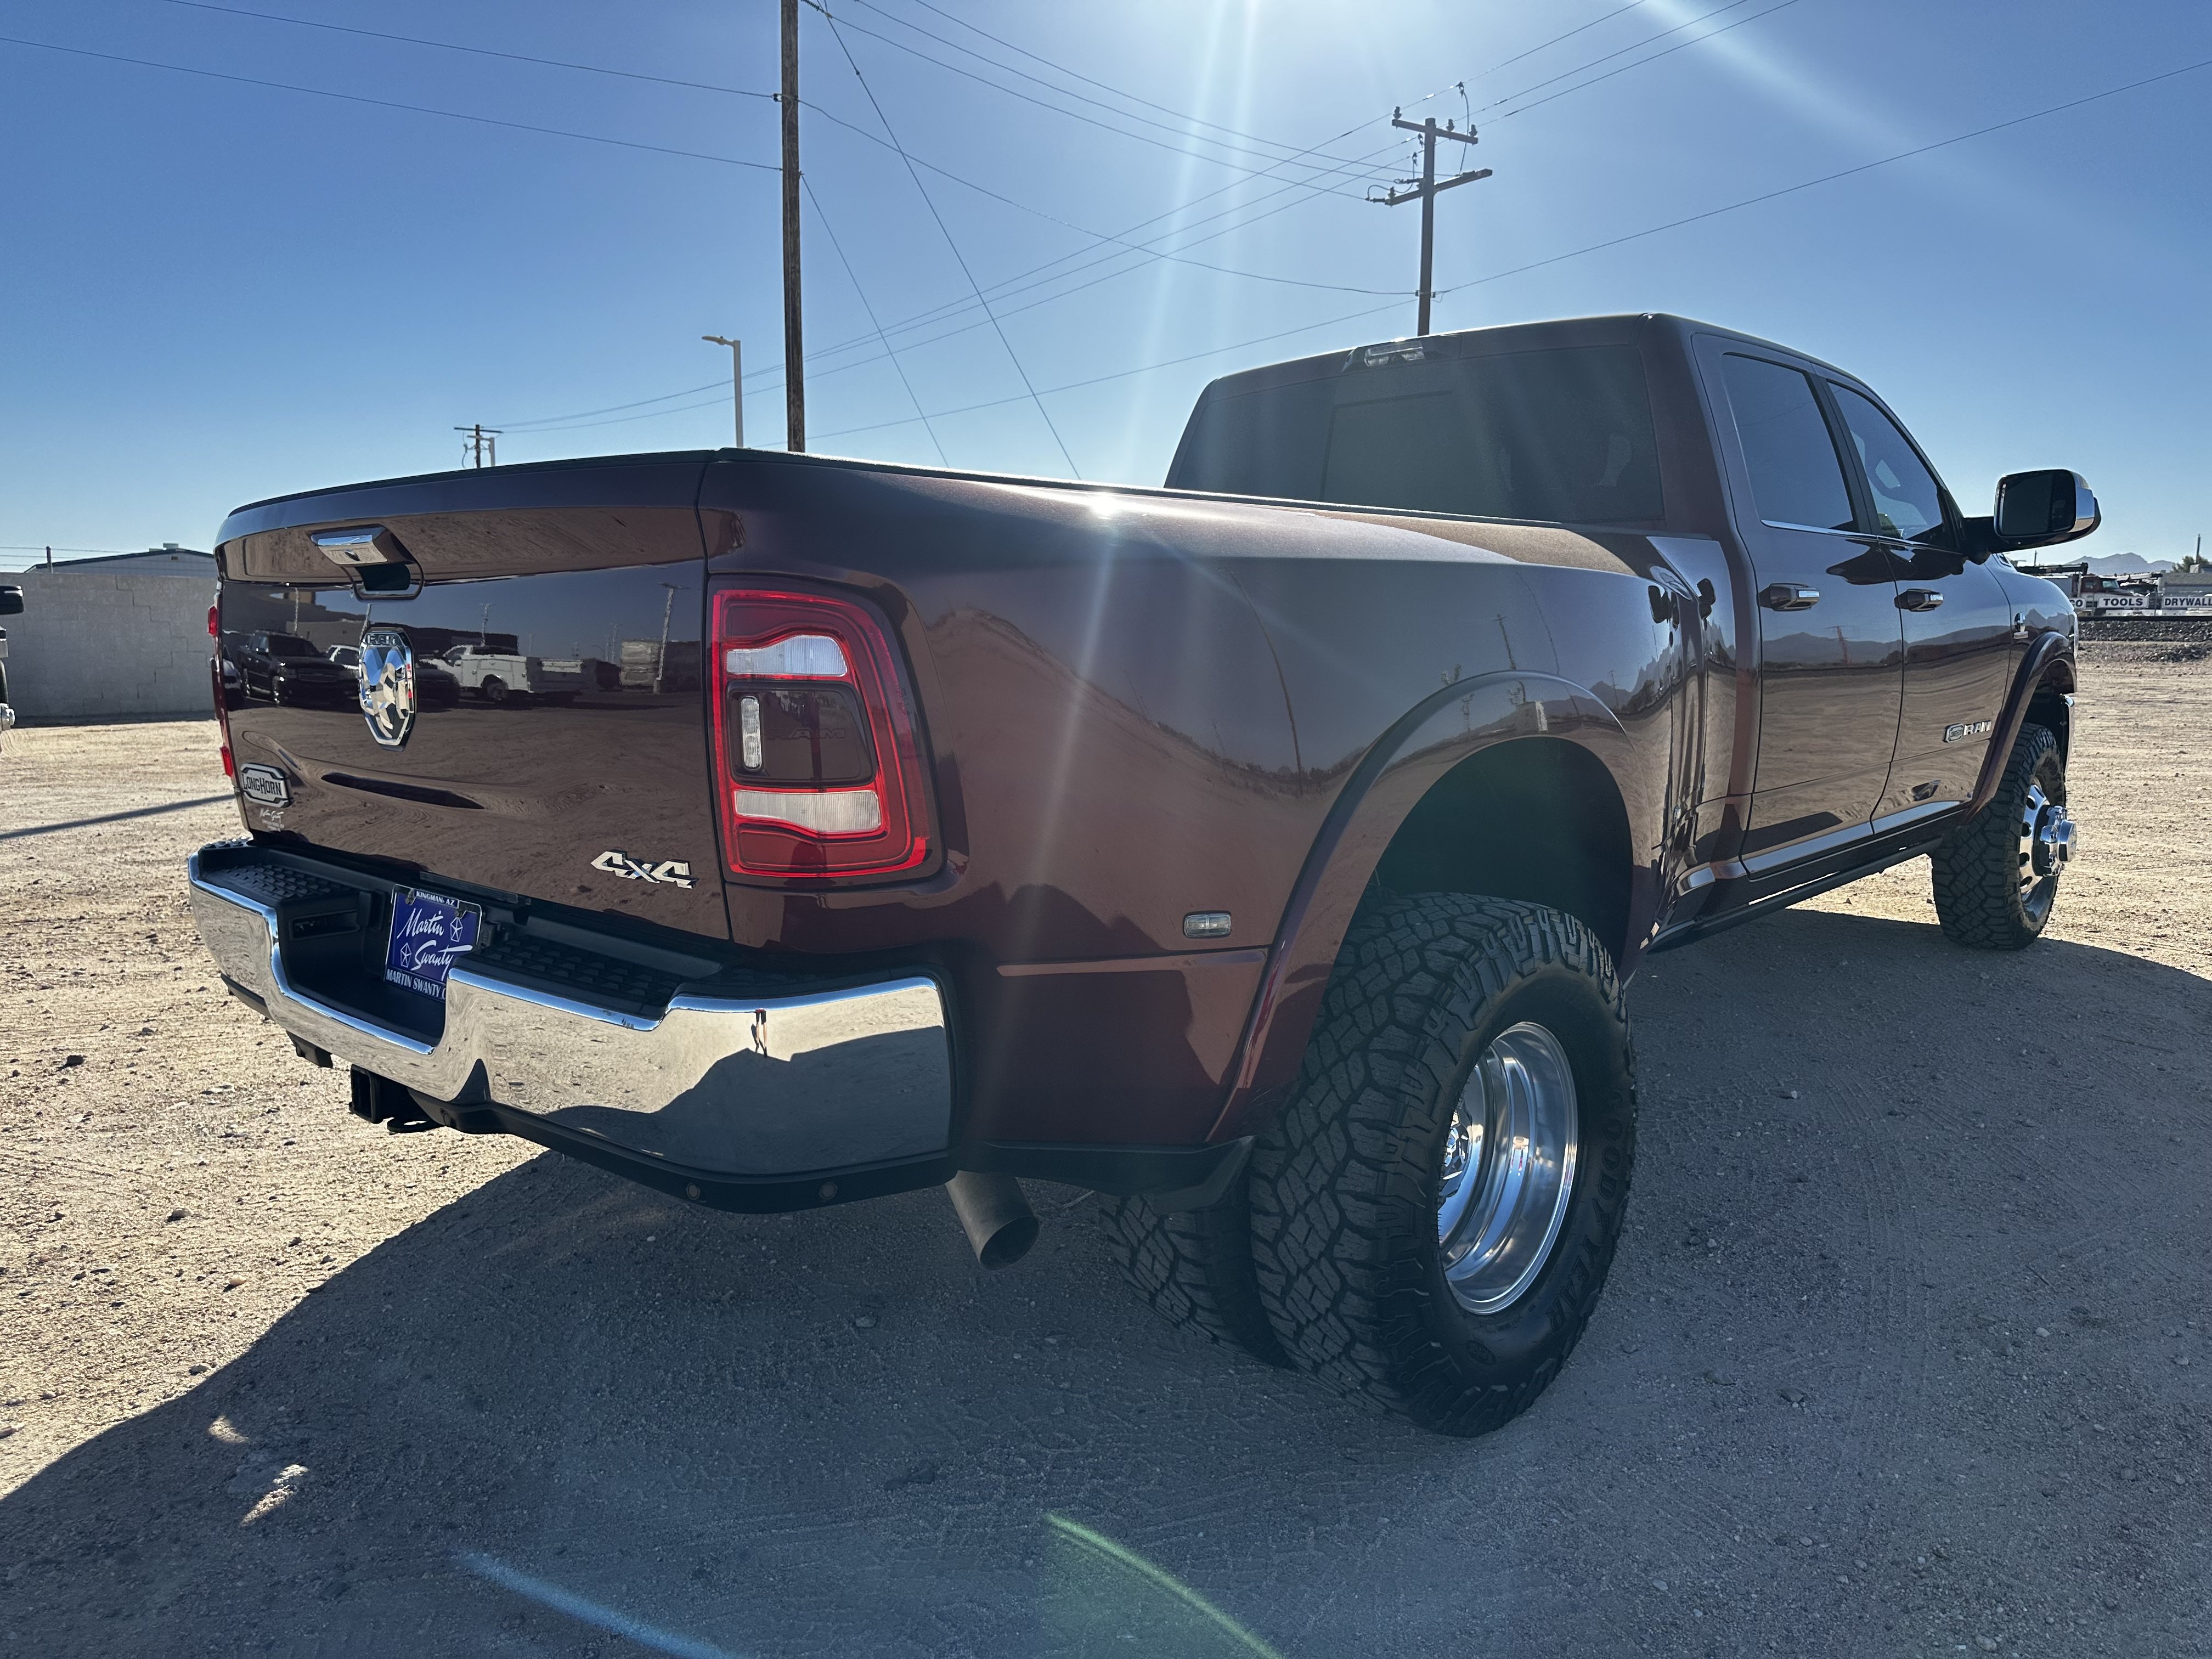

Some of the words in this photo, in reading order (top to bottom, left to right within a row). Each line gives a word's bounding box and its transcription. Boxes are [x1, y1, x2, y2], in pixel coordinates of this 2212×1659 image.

[1963, 720, 1991, 736] RAM
[241, 774, 282, 795] LONGHORN
[397, 907, 444, 939] Martin
[410, 940, 473, 981] Swanty
[386, 969, 412, 988] MARTIN
[413, 978, 442, 998] SWANTY
